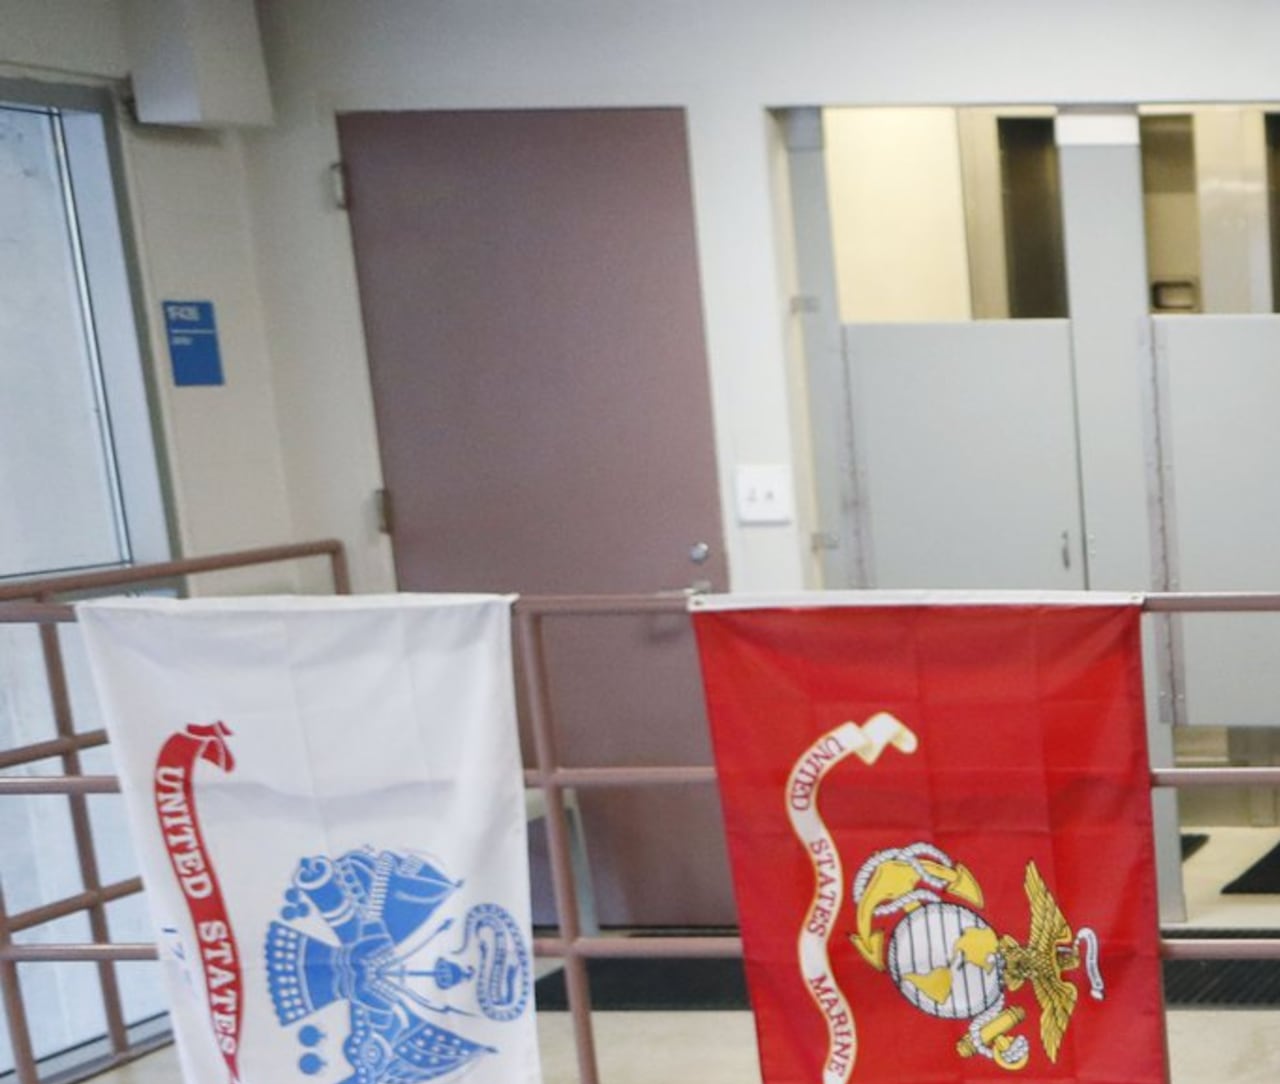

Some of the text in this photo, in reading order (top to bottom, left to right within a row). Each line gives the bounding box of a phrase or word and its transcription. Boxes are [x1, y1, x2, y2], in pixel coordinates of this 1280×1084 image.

[791, 736, 844, 812] UNITED
[156, 766, 212, 898] UNITED
[199, 919, 235, 1055] STATES
[808, 838, 837, 937] STATES
[810, 973, 852, 1077] MARINE
